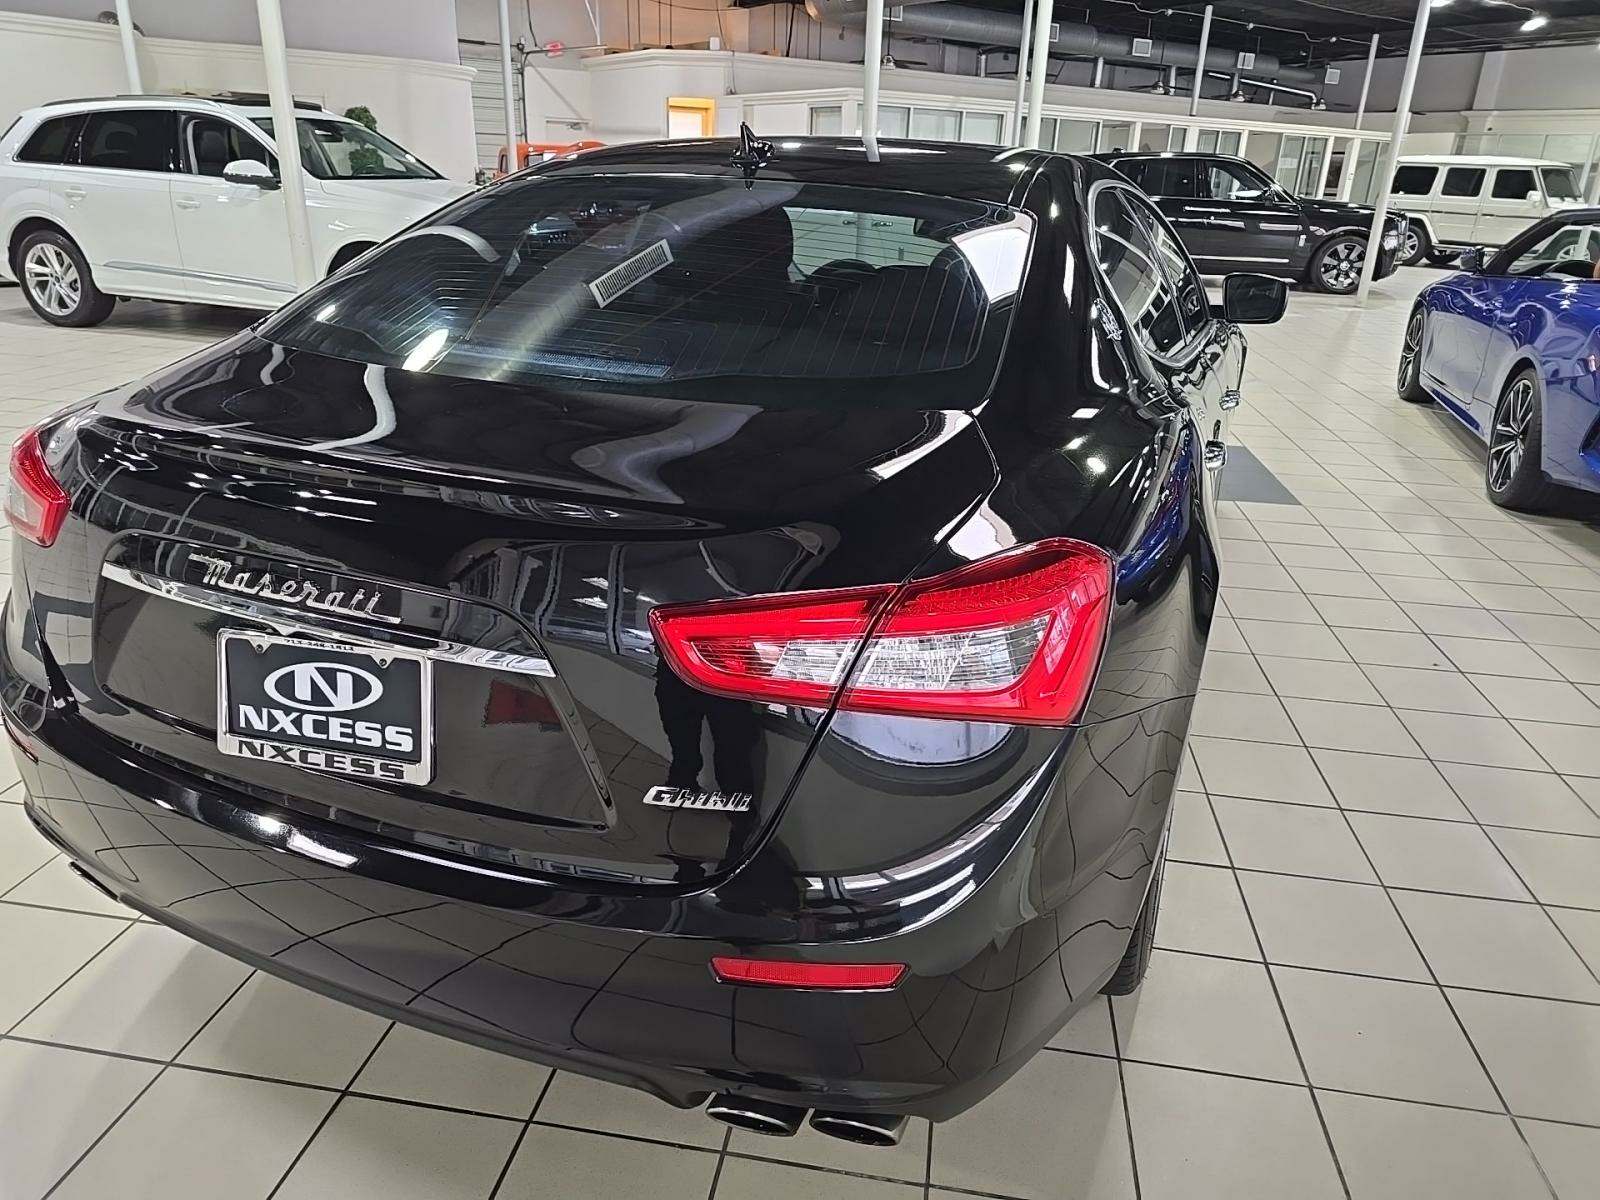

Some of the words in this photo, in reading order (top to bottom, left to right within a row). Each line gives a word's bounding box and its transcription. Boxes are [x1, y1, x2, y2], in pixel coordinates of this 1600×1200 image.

[188, 553, 401, 624] Maserati
[238, 704, 414, 753] NXCESS
[238, 740, 406, 780] NXCESS
[643, 785, 753, 812] Ghibli
